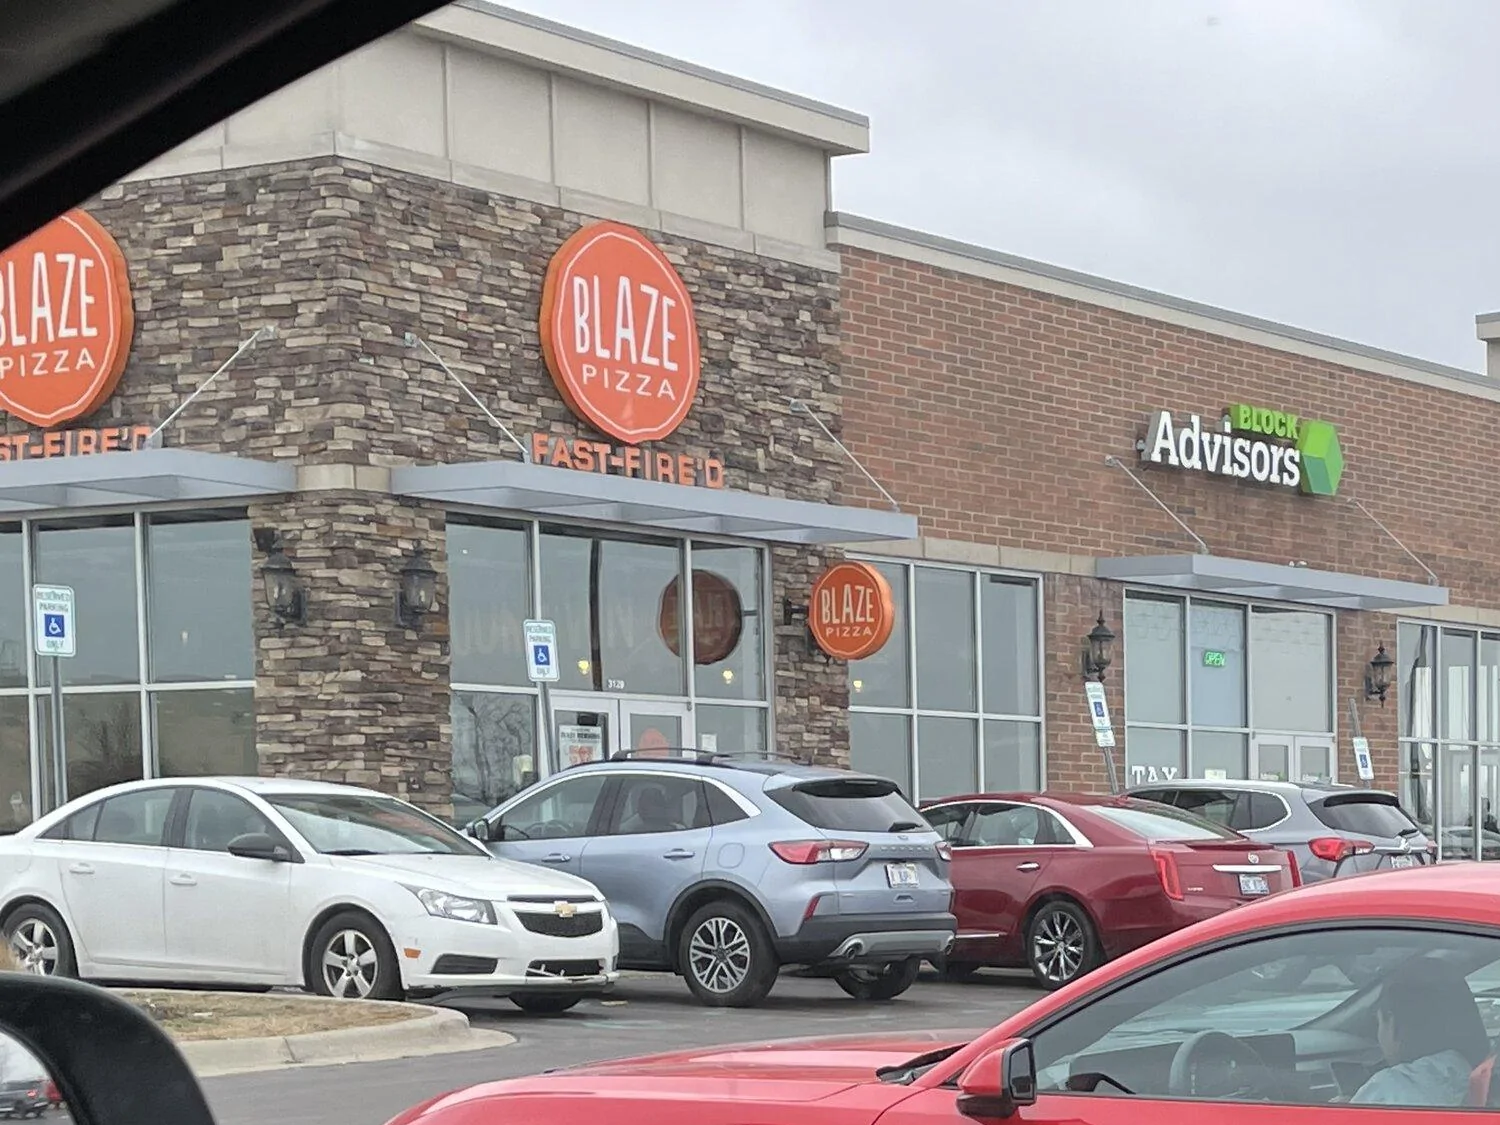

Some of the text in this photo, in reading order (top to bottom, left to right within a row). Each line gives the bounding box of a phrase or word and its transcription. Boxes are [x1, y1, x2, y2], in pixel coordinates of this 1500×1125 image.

[0, 251, 98, 346] LAZE
[573, 275, 679, 371] BLAZE
[0, 347, 95, 379] PIZZA
[582, 363, 676, 400] PIZZA
[1238, 404, 1299, 439] BLOCK
[1150, 411, 1301, 487] Advisors
[821, 583, 875, 624] BLAZE
[825, 626, 873, 638] PIZZA
